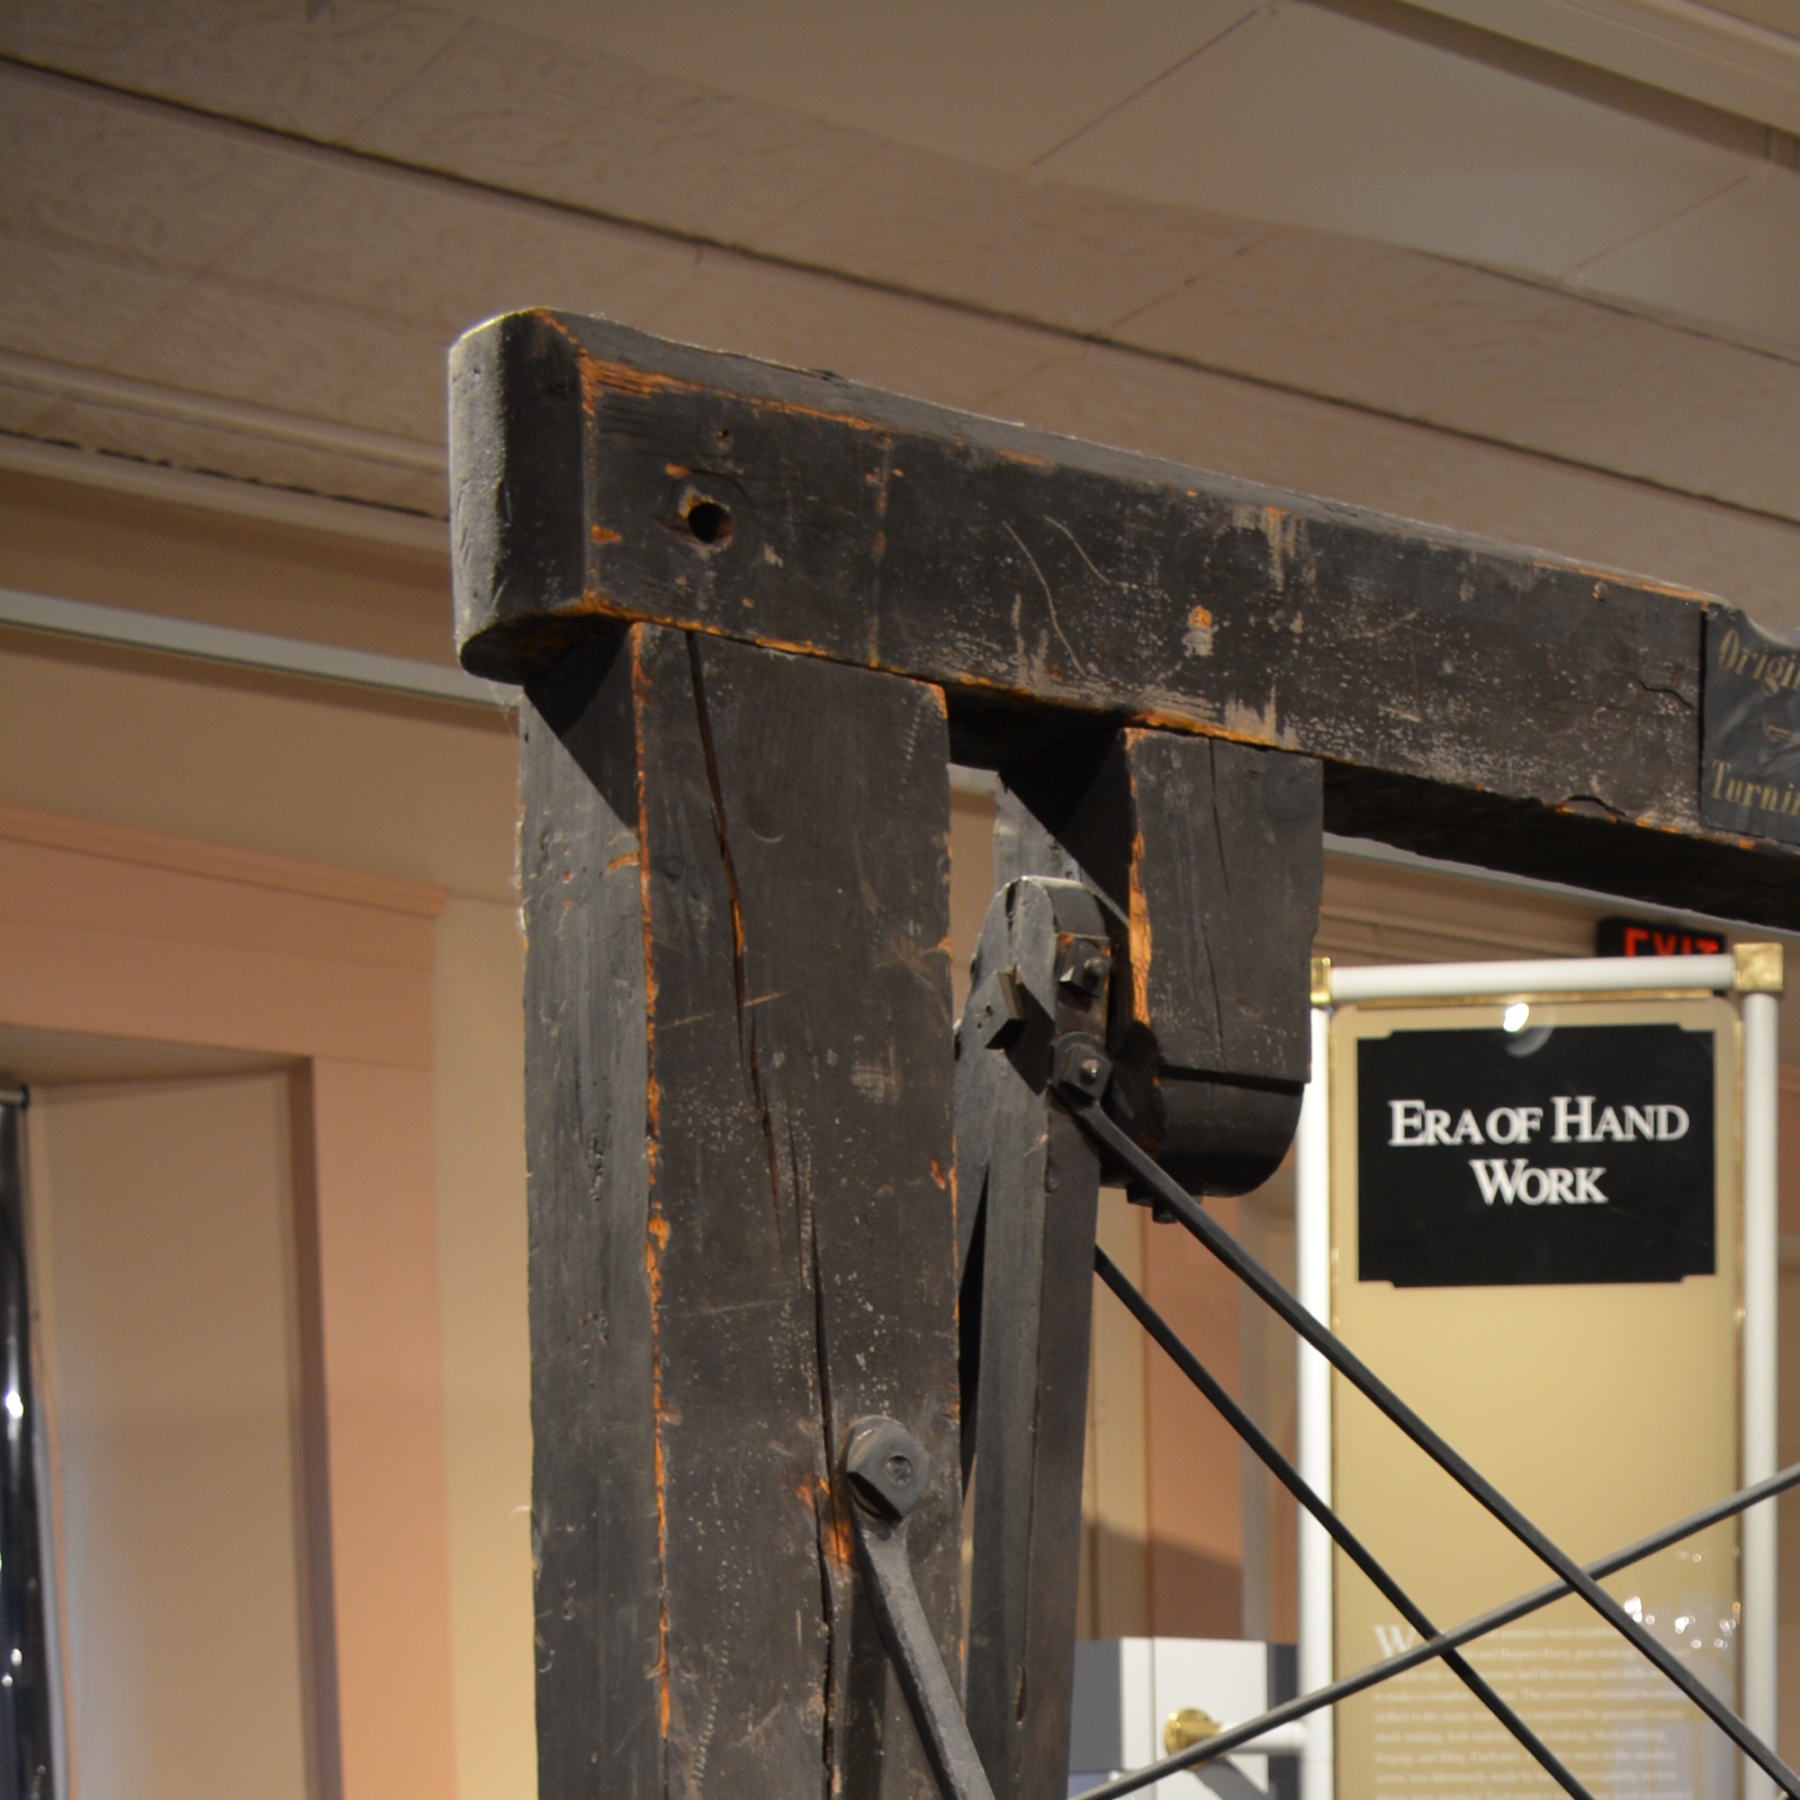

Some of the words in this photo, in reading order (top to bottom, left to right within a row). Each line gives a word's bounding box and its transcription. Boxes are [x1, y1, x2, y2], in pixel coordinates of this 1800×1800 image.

[1388, 1100, 1485, 1146] ERA
[1485, 1106, 1543, 1145] OF
[1550, 1095, 1690, 1143] HAND
[1468, 1158, 1609, 1206] WORK
